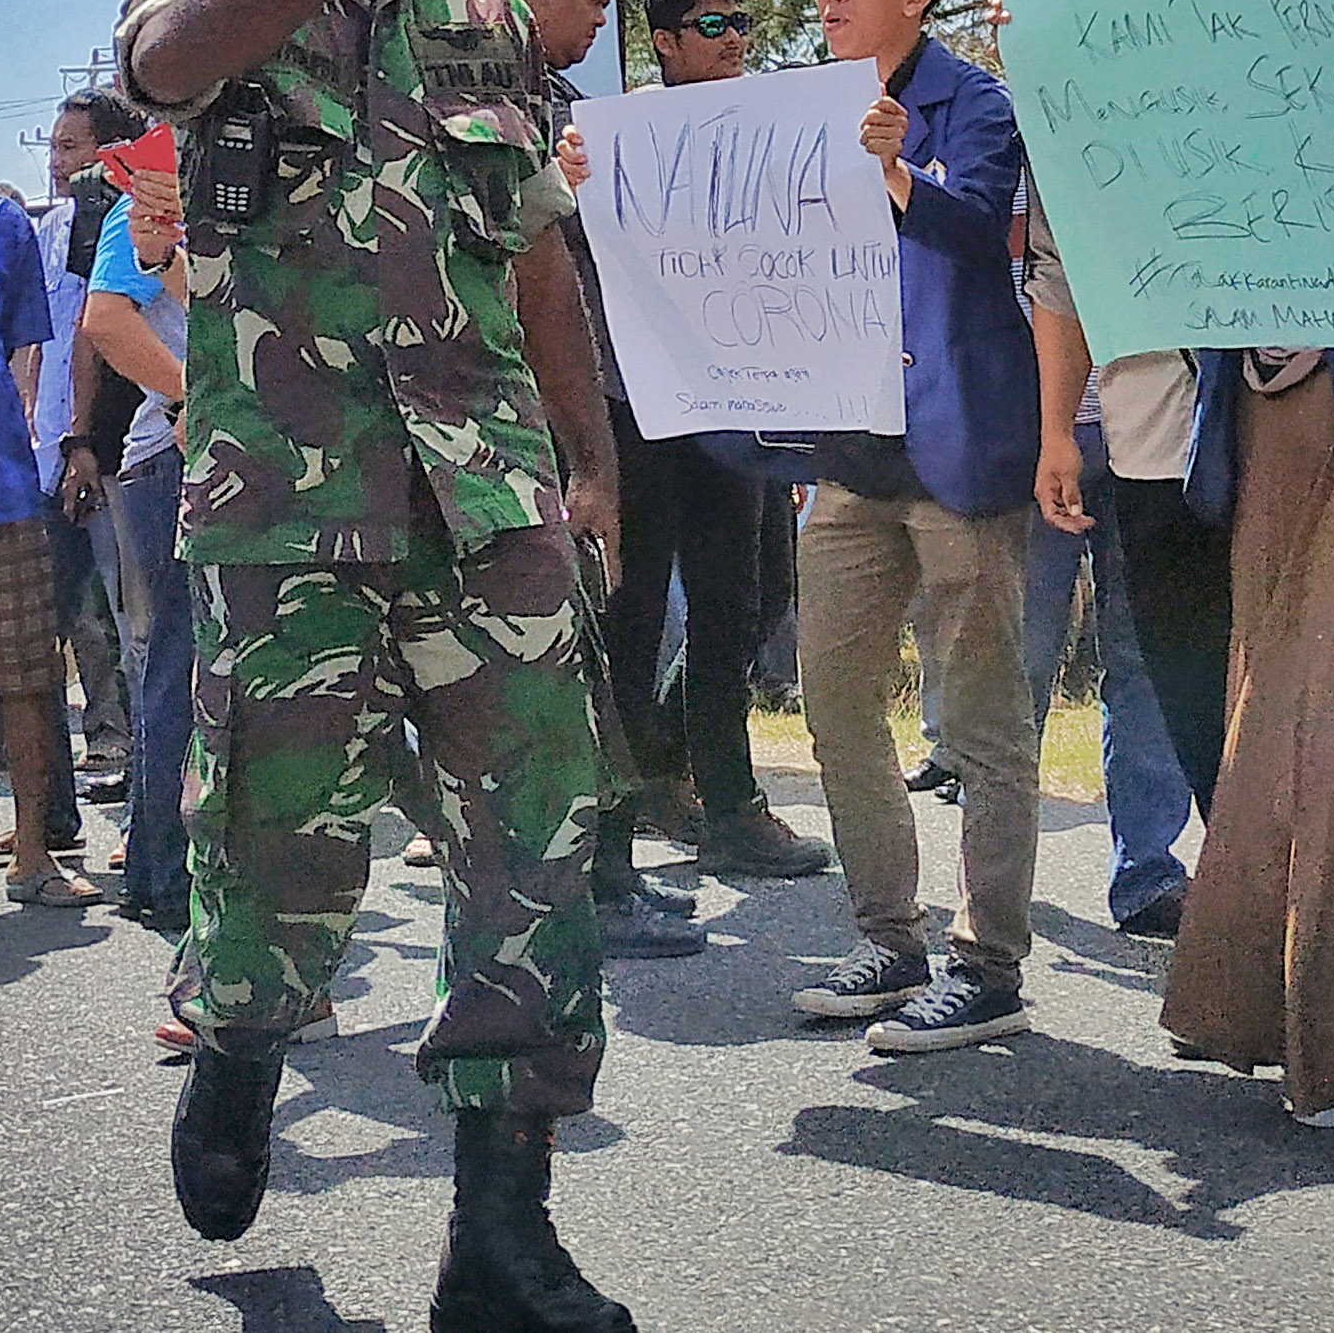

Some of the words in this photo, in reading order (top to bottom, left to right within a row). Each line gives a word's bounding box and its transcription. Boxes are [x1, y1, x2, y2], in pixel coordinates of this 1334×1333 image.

[1074, 9, 1175, 63] KAMI
[612, 105, 841, 239] NATUNA
[655, 244, 728, 279] TIDAK
[702, 281, 889, 348] CORONA
